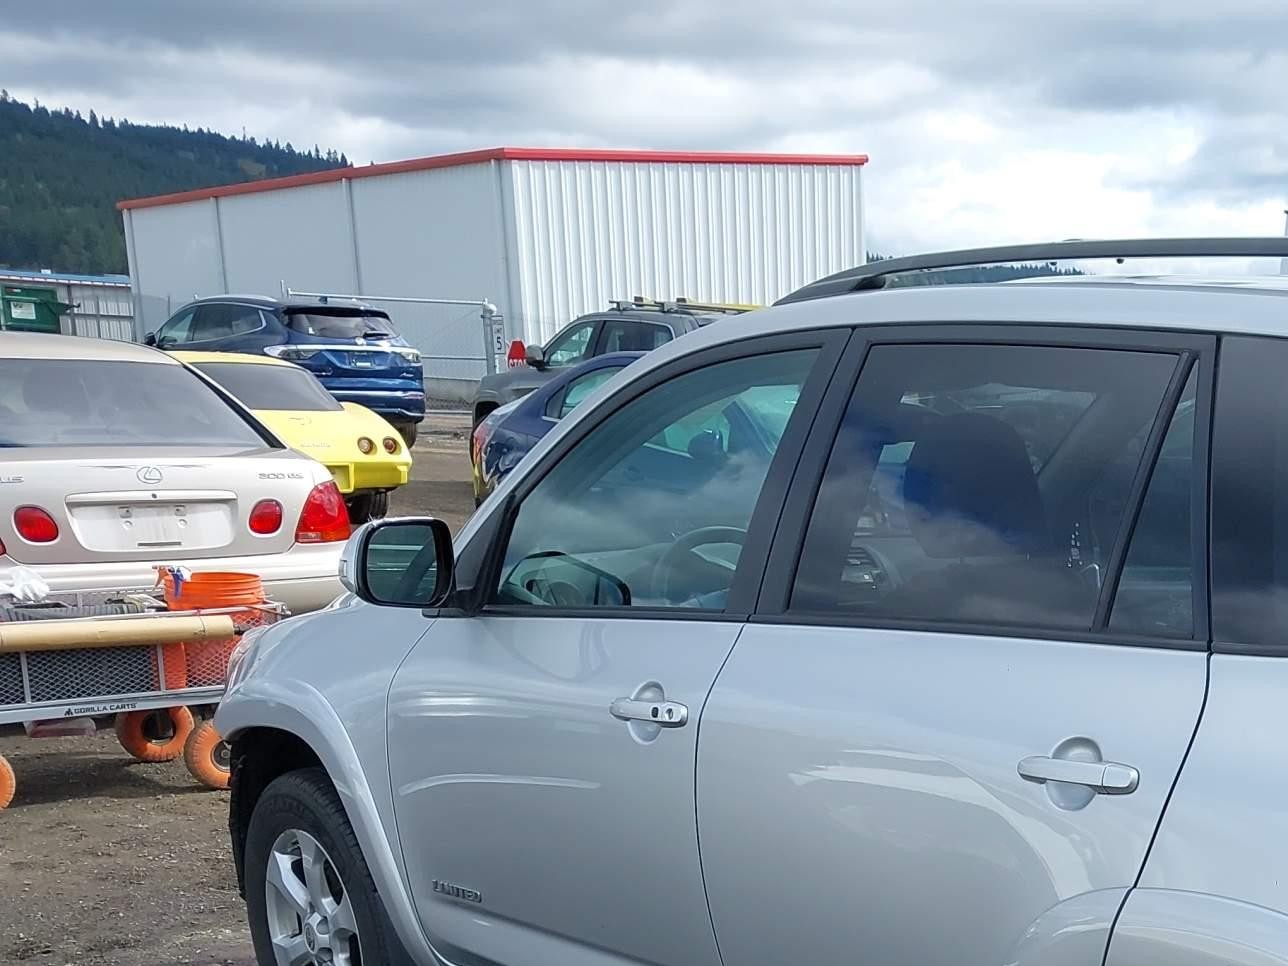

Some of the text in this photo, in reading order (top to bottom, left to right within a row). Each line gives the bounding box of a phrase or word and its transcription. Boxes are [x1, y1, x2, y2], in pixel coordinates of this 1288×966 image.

[496, 335, 503, 351] 5
[73, 702, 137, 715] GORILLA CARTS
[432, 879, 482, 904] LIMITED
